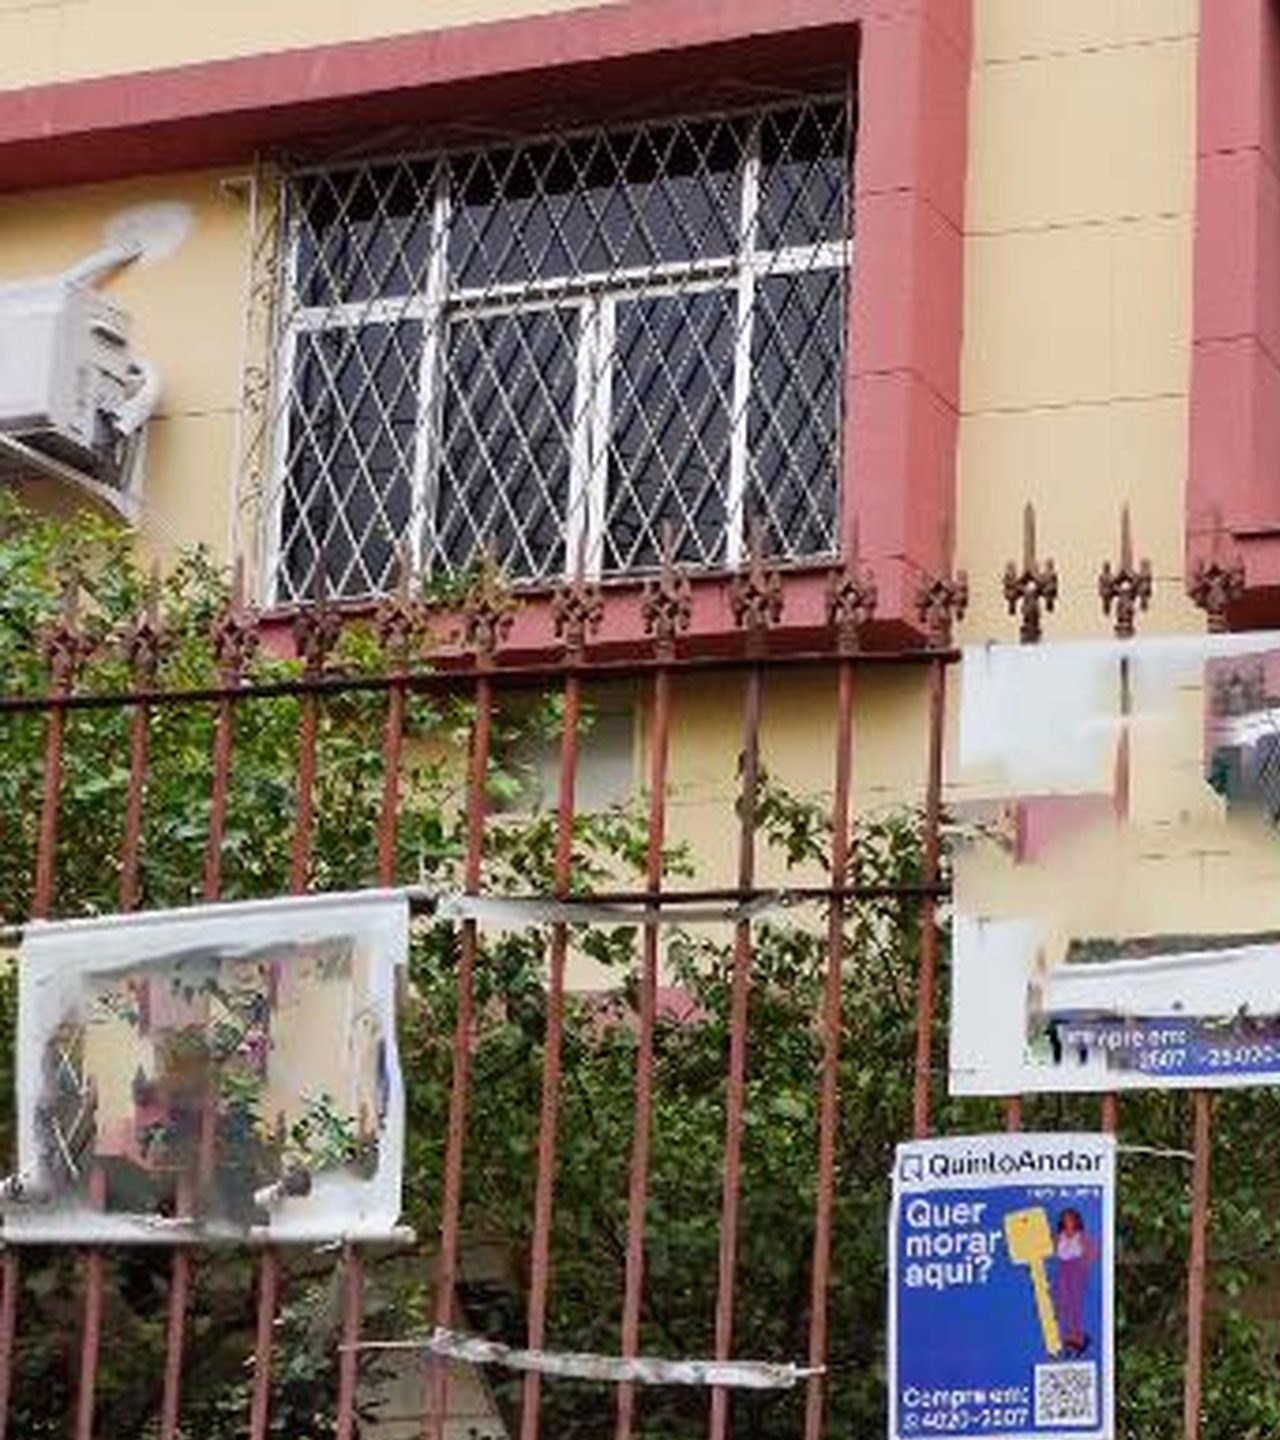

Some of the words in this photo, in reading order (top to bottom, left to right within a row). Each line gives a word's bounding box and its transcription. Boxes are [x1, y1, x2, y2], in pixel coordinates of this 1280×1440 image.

[927, 1149, 1102, 1180] QuintoAndar
[906, 1198, 987, 1229] Quer
[906, 1230, 1002, 1257] morar
[905, 1255, 994, 1292] aqui?
